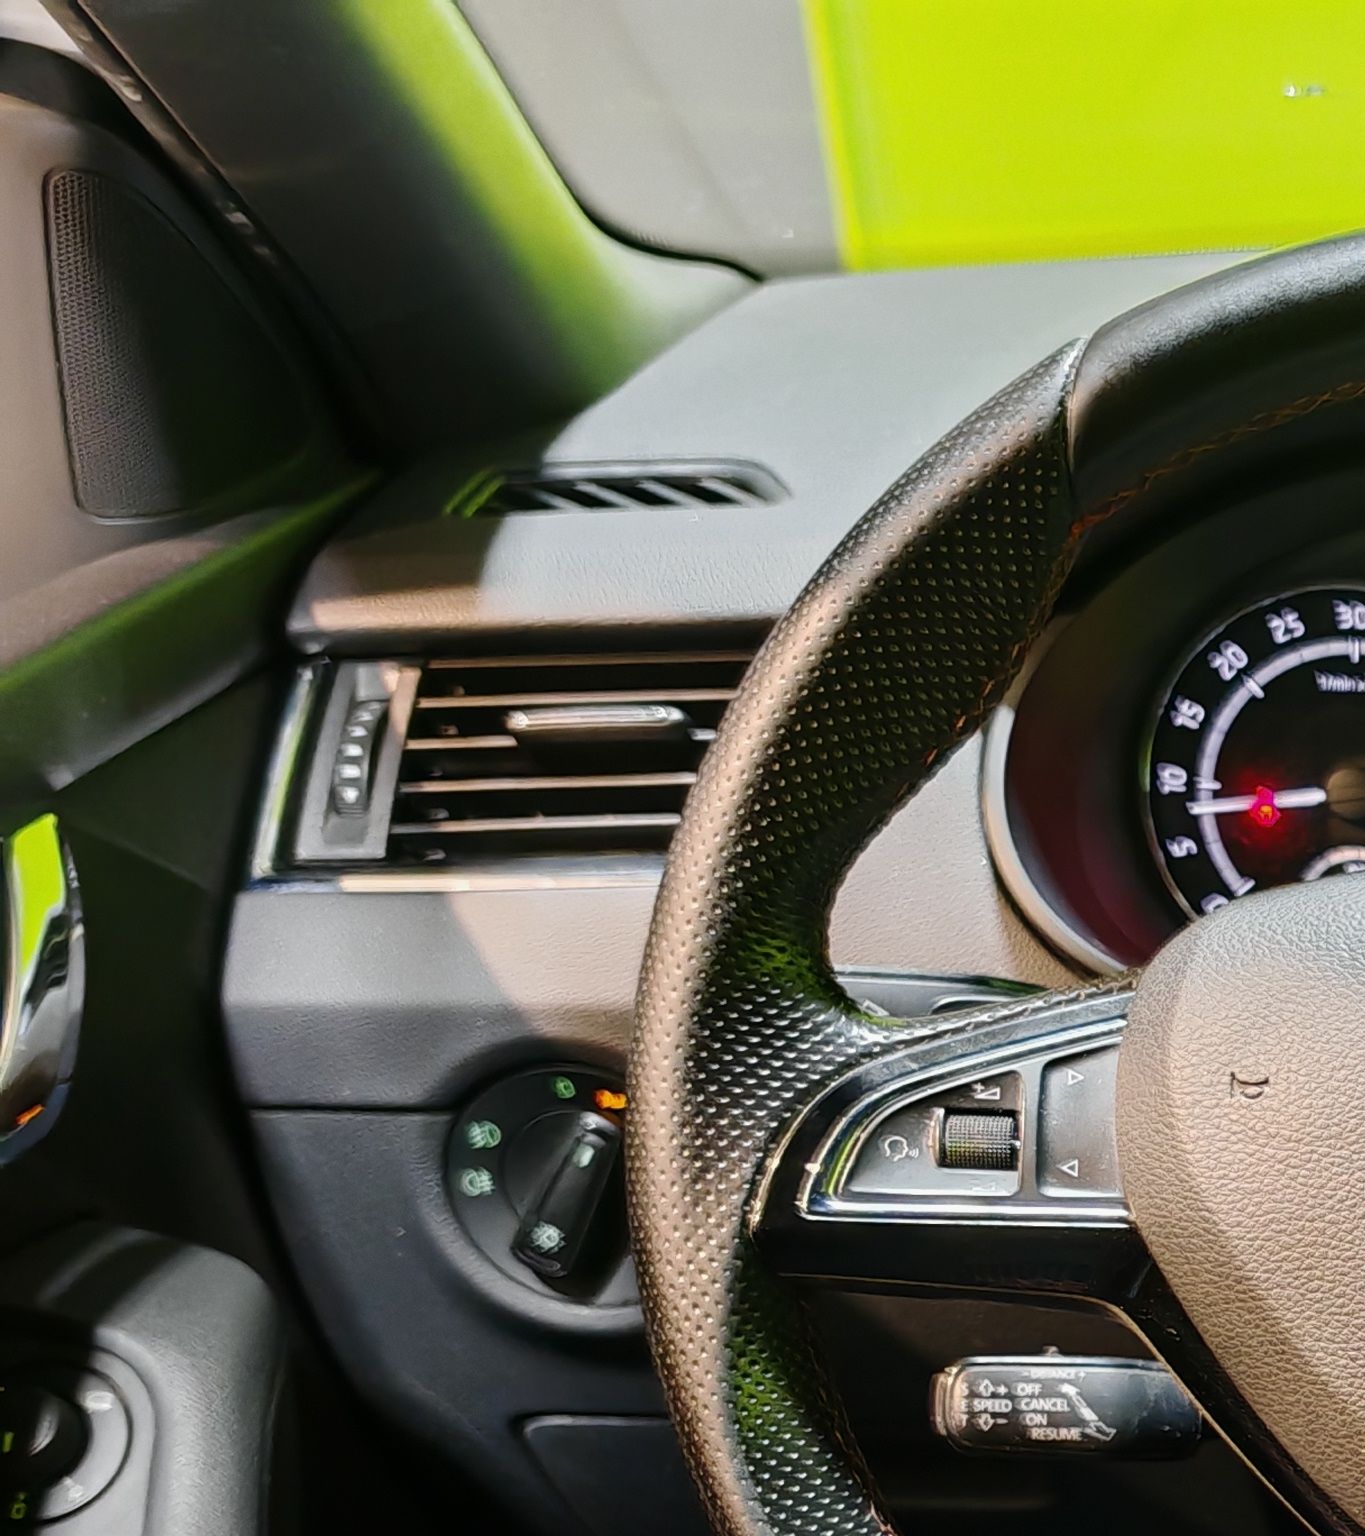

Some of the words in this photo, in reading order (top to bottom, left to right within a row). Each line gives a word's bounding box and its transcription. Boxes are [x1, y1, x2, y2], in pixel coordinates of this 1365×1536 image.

[1265, 607, 1305, 644] 25
[1207, 640, 1249, 681] 20
[1170, 695, 1205, 730] 15
[1156, 762, 1187, 794] 10
[1165, 835, 1197, 857] 5
[1014, 1382, 1043, 1396] OFF
[973, 1398, 1012, 1412] SPEED
[1018, 1398, 1069, 1412] CANCEL
[1023, 1413, 1048, 1426] ON
[1028, 1427, 1083, 1441] RESUME
